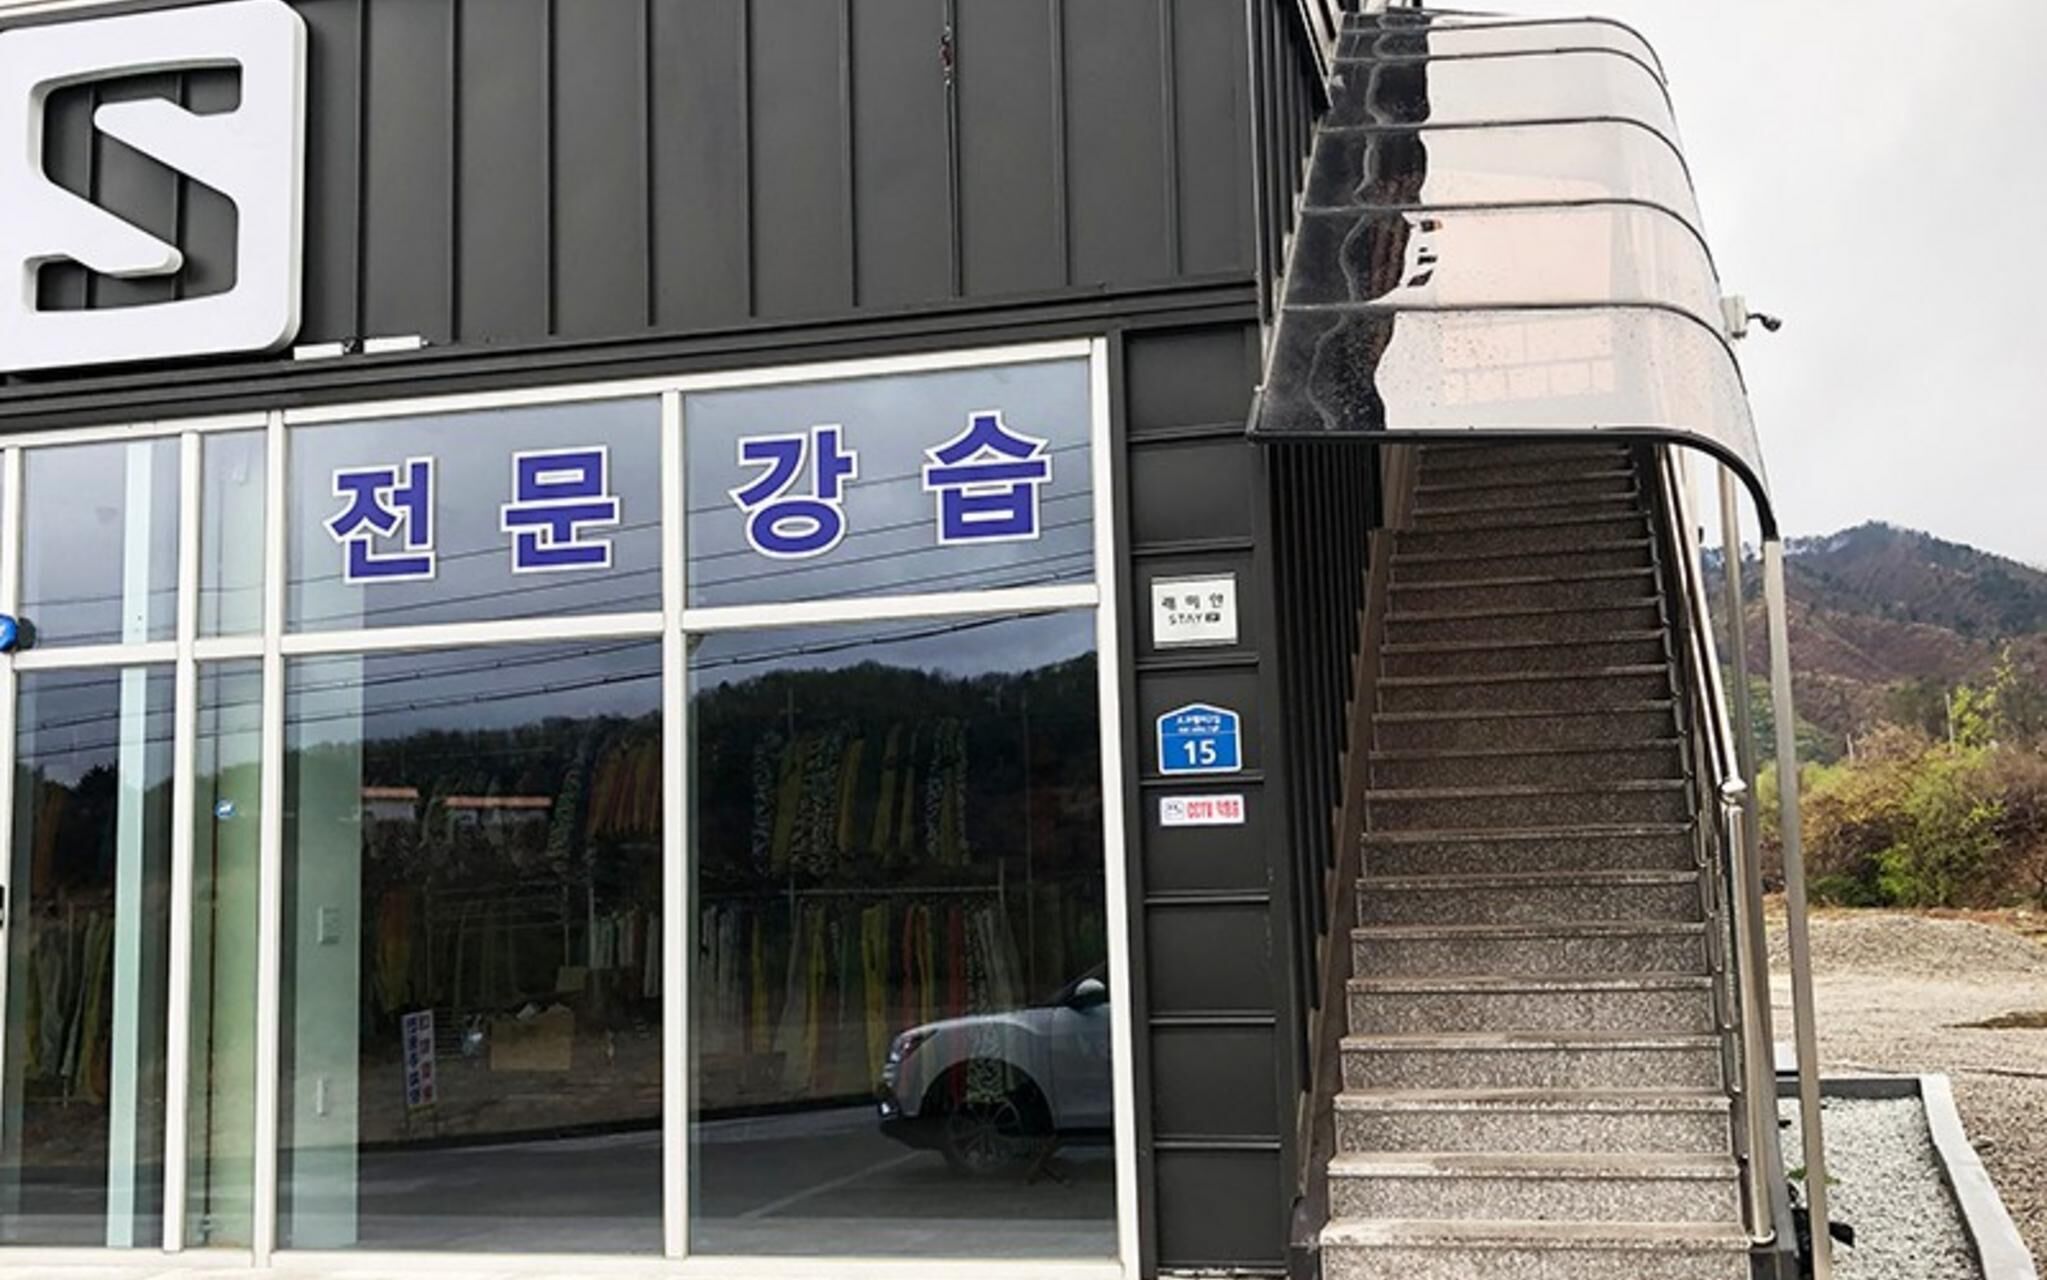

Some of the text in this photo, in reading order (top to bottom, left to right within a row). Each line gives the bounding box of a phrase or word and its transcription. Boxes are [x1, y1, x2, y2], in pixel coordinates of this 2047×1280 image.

[323, 410, 1052, 584] 전문 강습
[1183, 738, 1217, 765] 15
